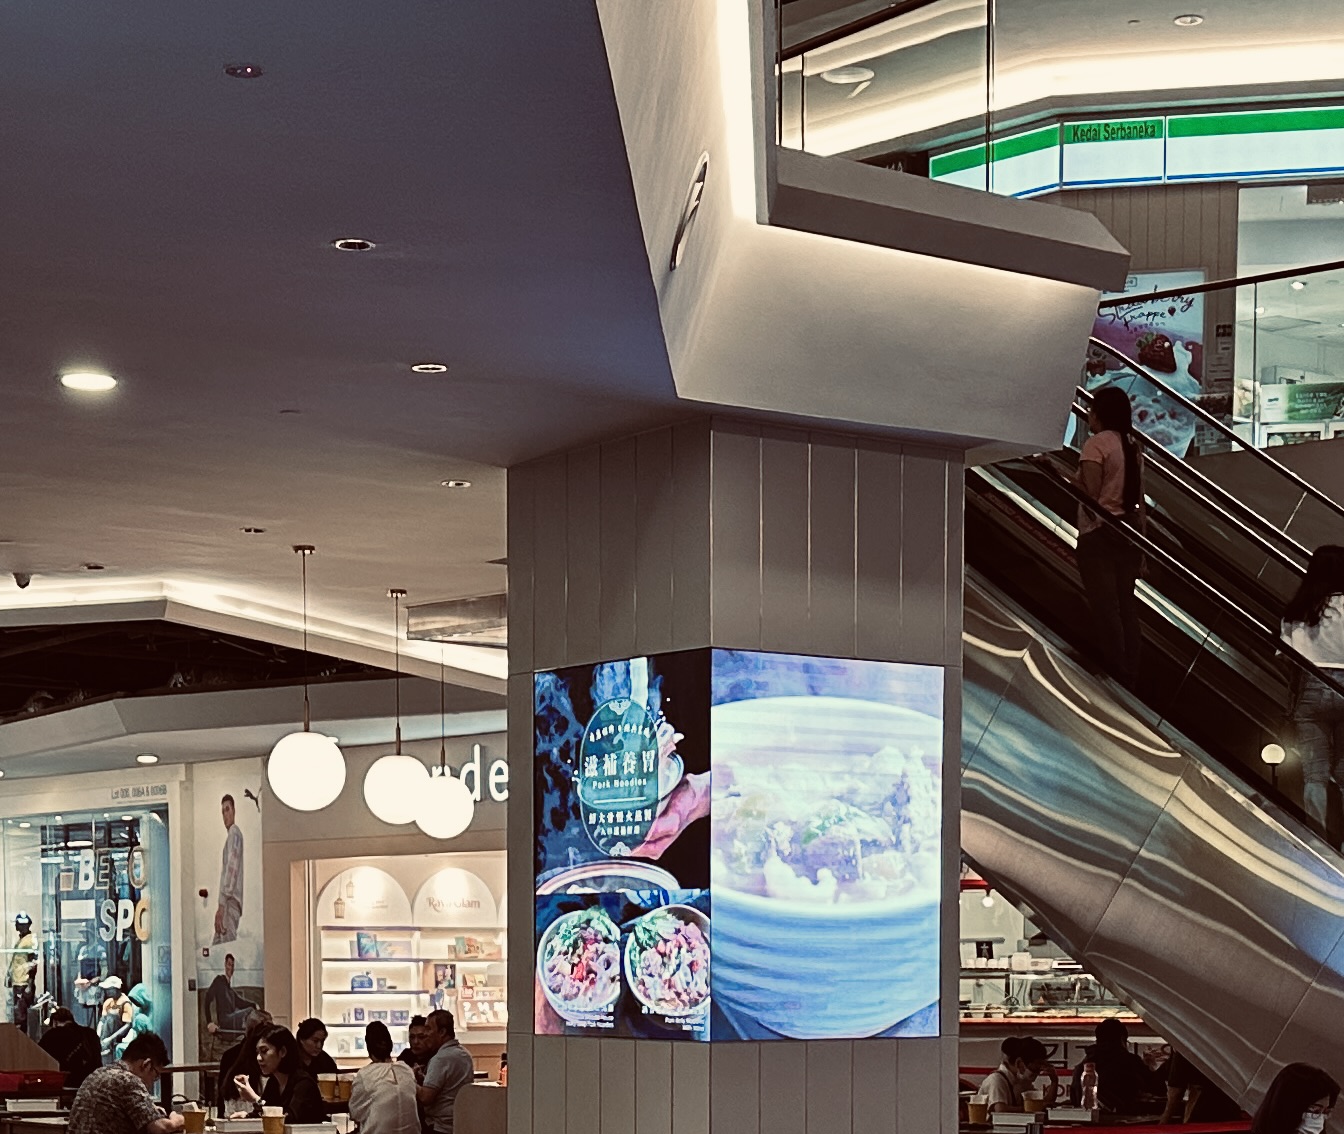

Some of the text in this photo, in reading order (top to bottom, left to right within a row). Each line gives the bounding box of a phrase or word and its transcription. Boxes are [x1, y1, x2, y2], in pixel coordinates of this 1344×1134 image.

[1072, 121, 1156, 143] Kedai Serbaneka
[592, 778, 647, 789] Pork Noodles
